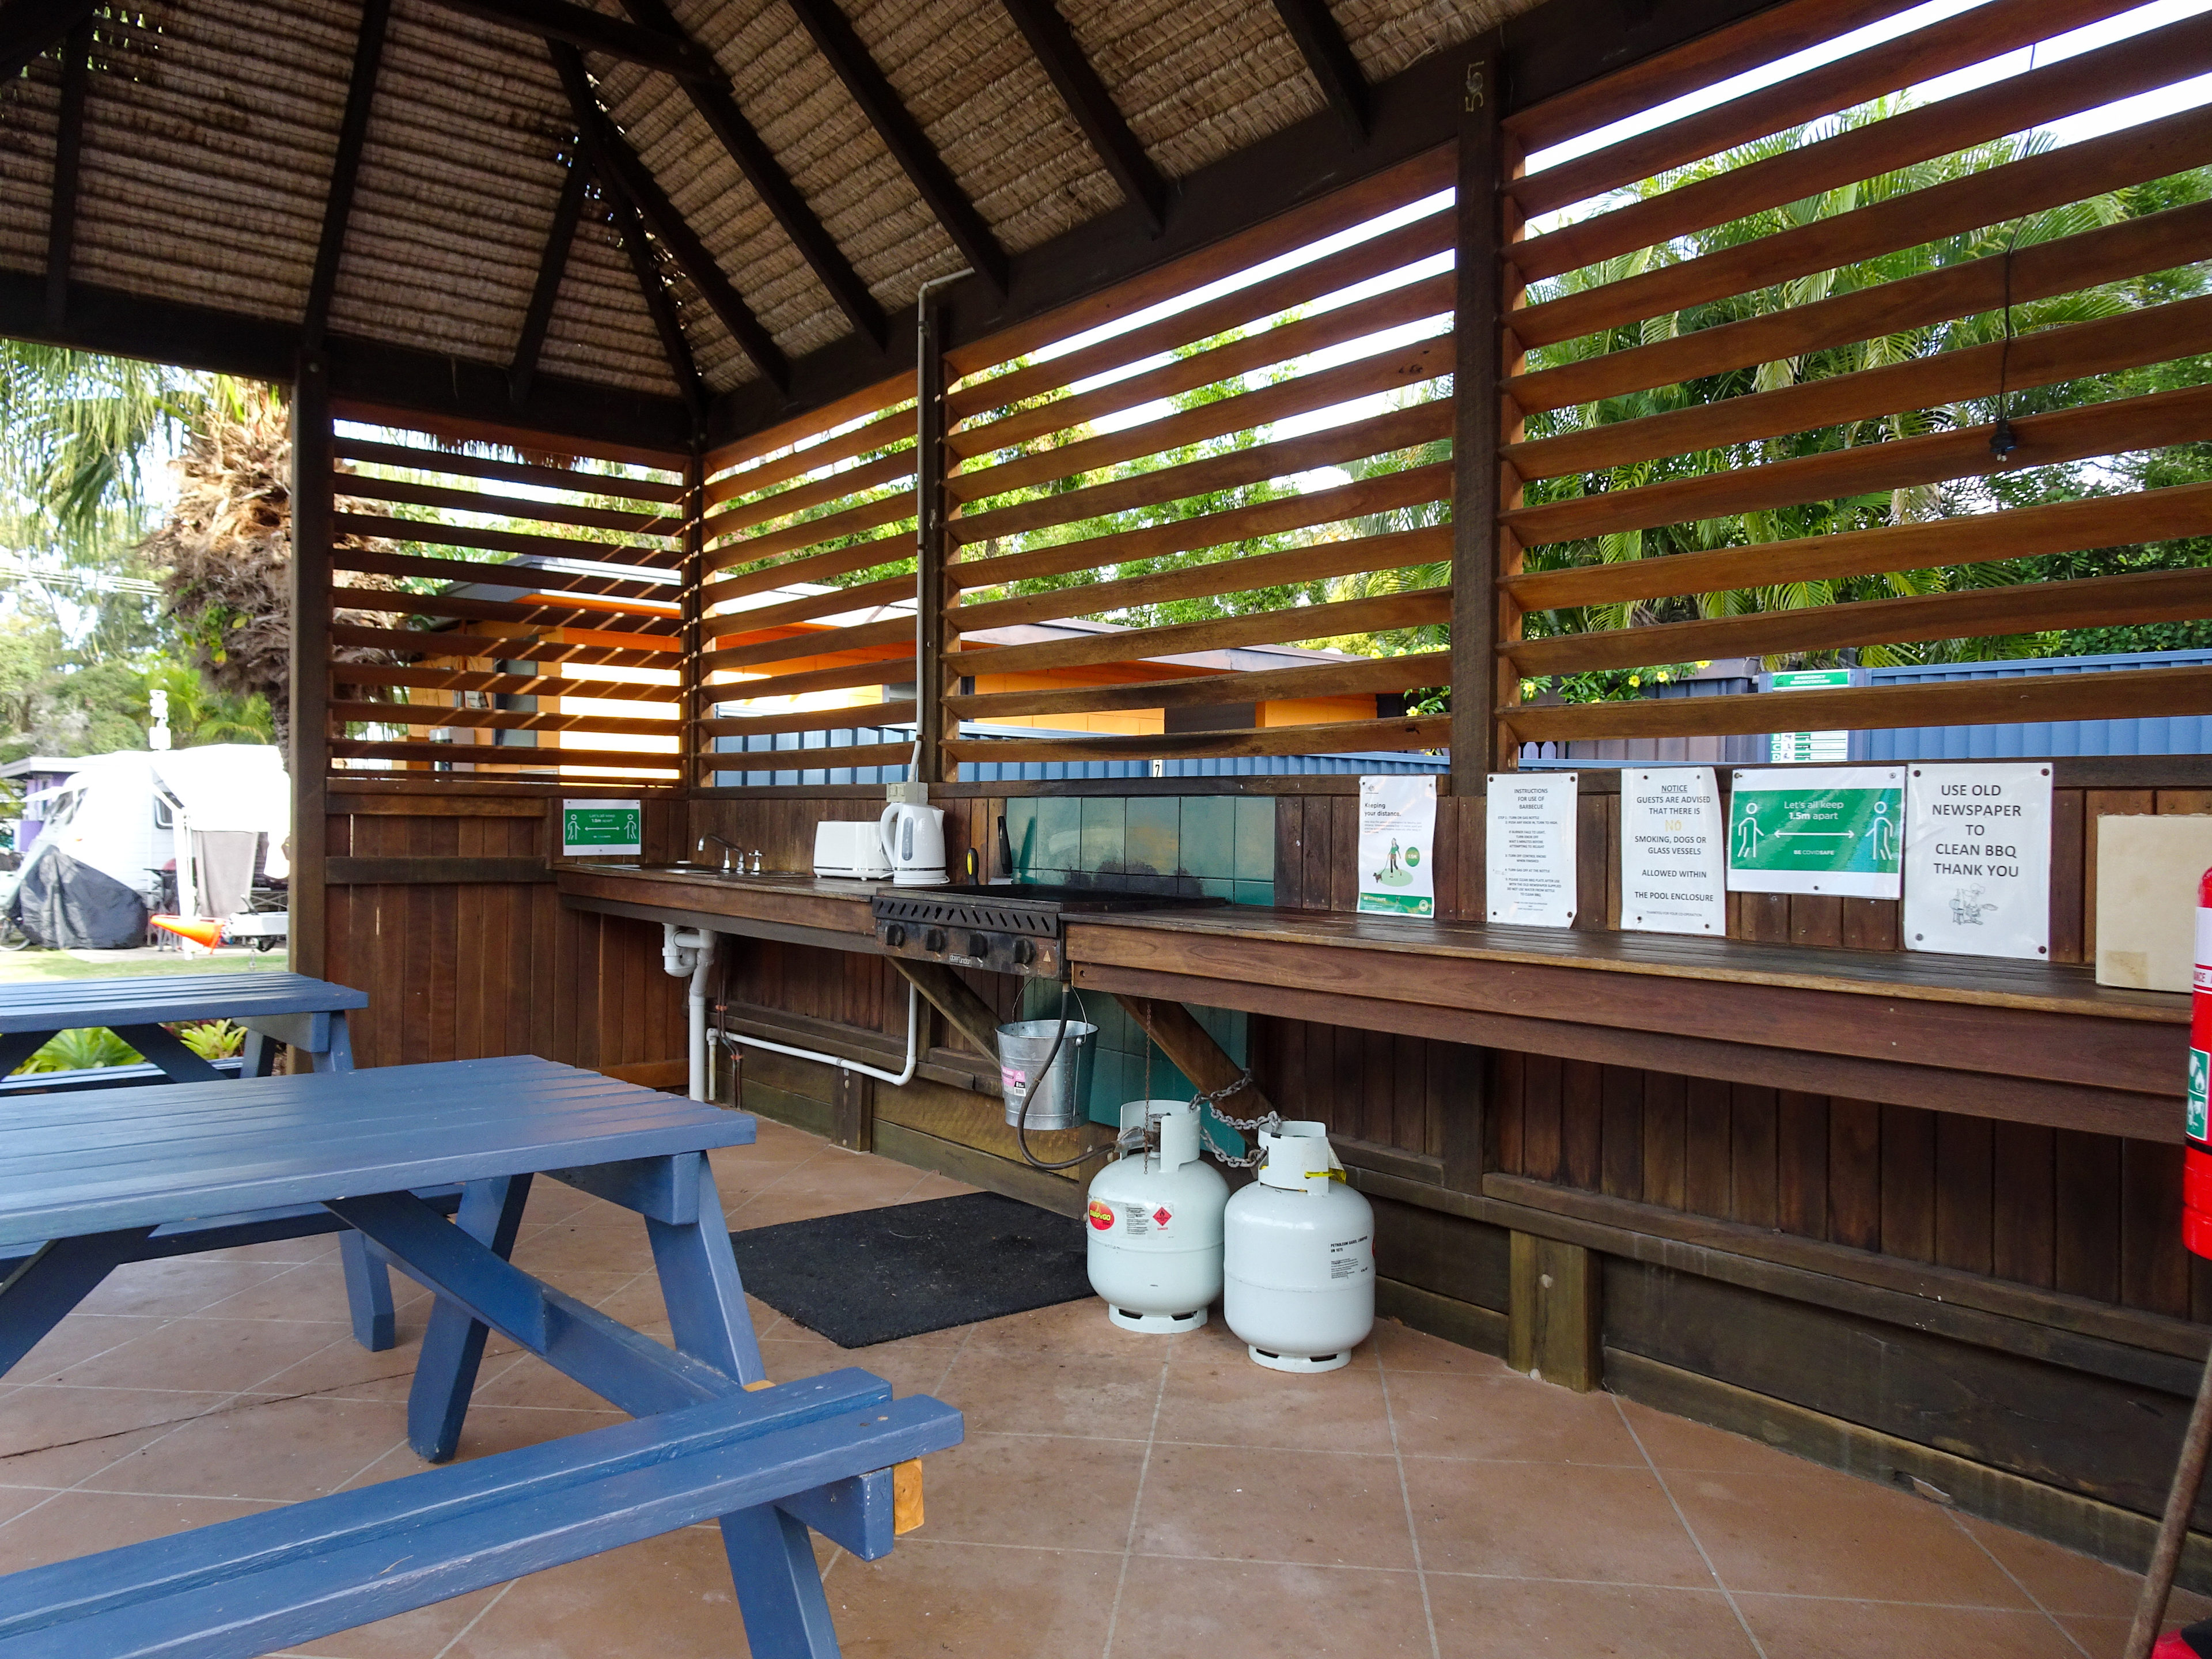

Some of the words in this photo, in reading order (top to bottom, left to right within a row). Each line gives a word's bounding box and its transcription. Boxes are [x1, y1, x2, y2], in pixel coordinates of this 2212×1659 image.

[1155, 764, 1160, 778] 7
[1941, 785, 1967, 796] USE
[1972, 785, 2001, 796] OLD
[1784, 801, 1805, 809] Let's
[1820, 801, 1844, 809] keep
[1932, 804, 2021, 816] NEWSPAPER
[1813, 812, 1839, 820] apart
[1665, 820, 1682, 832] NO
[1965, 824, 1985, 836] TO
[1936, 843, 1980, 855] CLEAN
[1985, 845, 2017, 858] BBQ
[1933, 863, 1983, 876] THANK
[1987, 865, 2018, 877] YOU
[1671, 893, 1714, 902] ENCLOSURE
